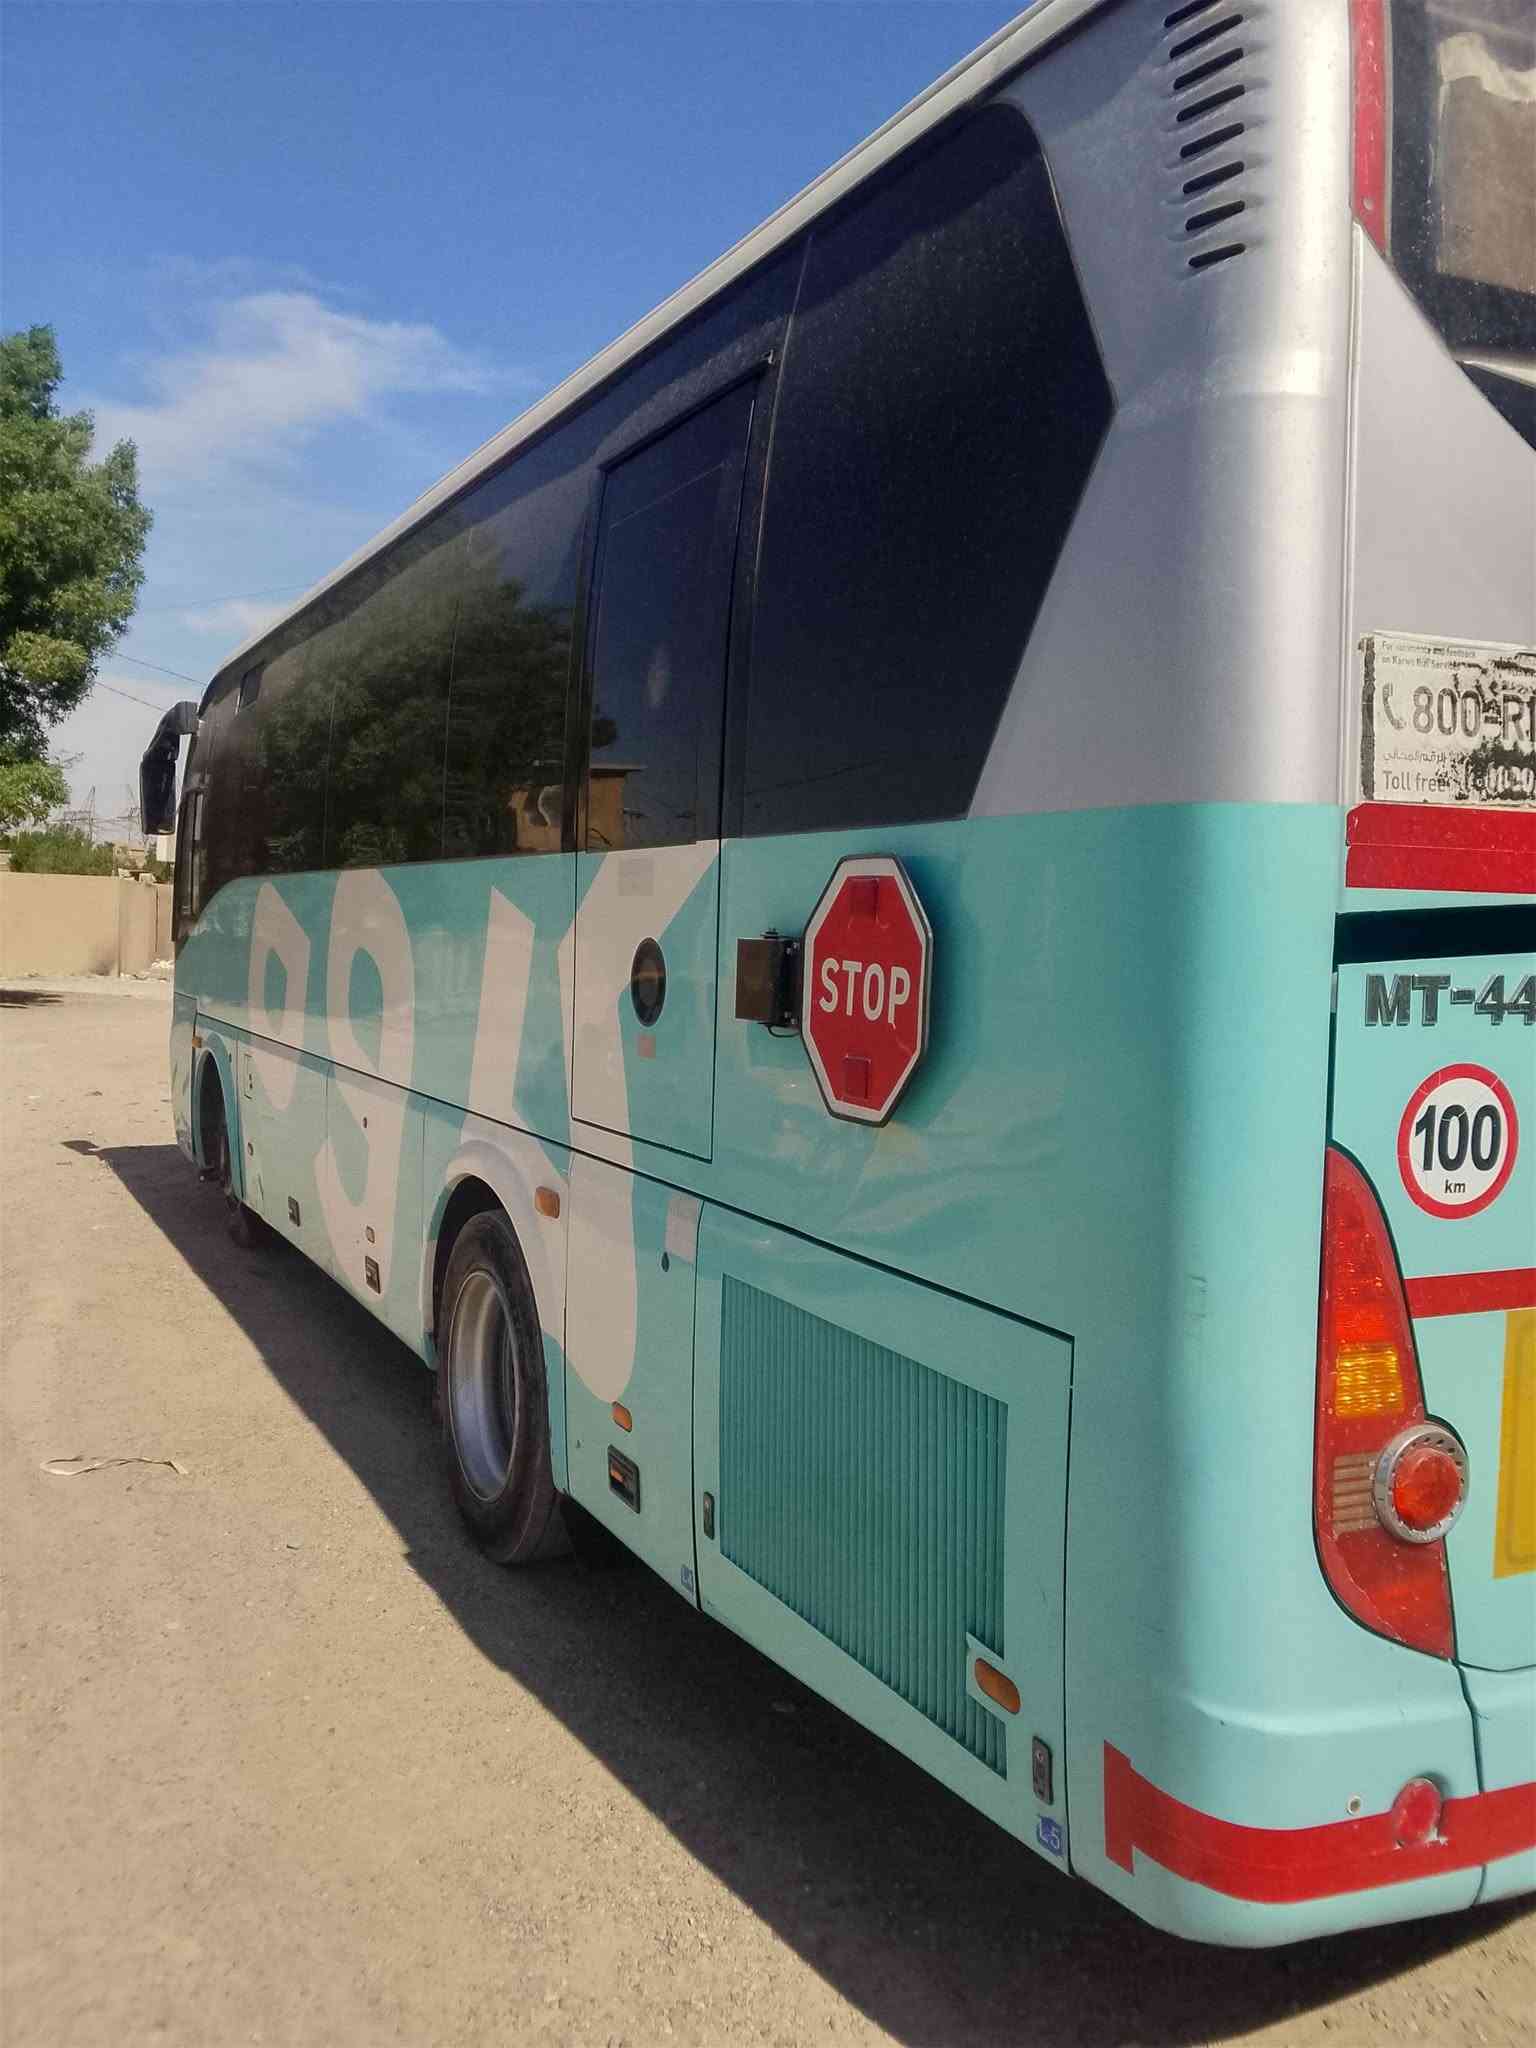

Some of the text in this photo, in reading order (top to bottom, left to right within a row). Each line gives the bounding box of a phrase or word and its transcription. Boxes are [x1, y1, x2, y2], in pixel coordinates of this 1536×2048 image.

[1383, 770, 1410, 791] Toll
[818, 957, 911, 1025] STOP
[1415, 1103, 1502, 1173] 100
[1444, 1178, 1467, 1195] km
